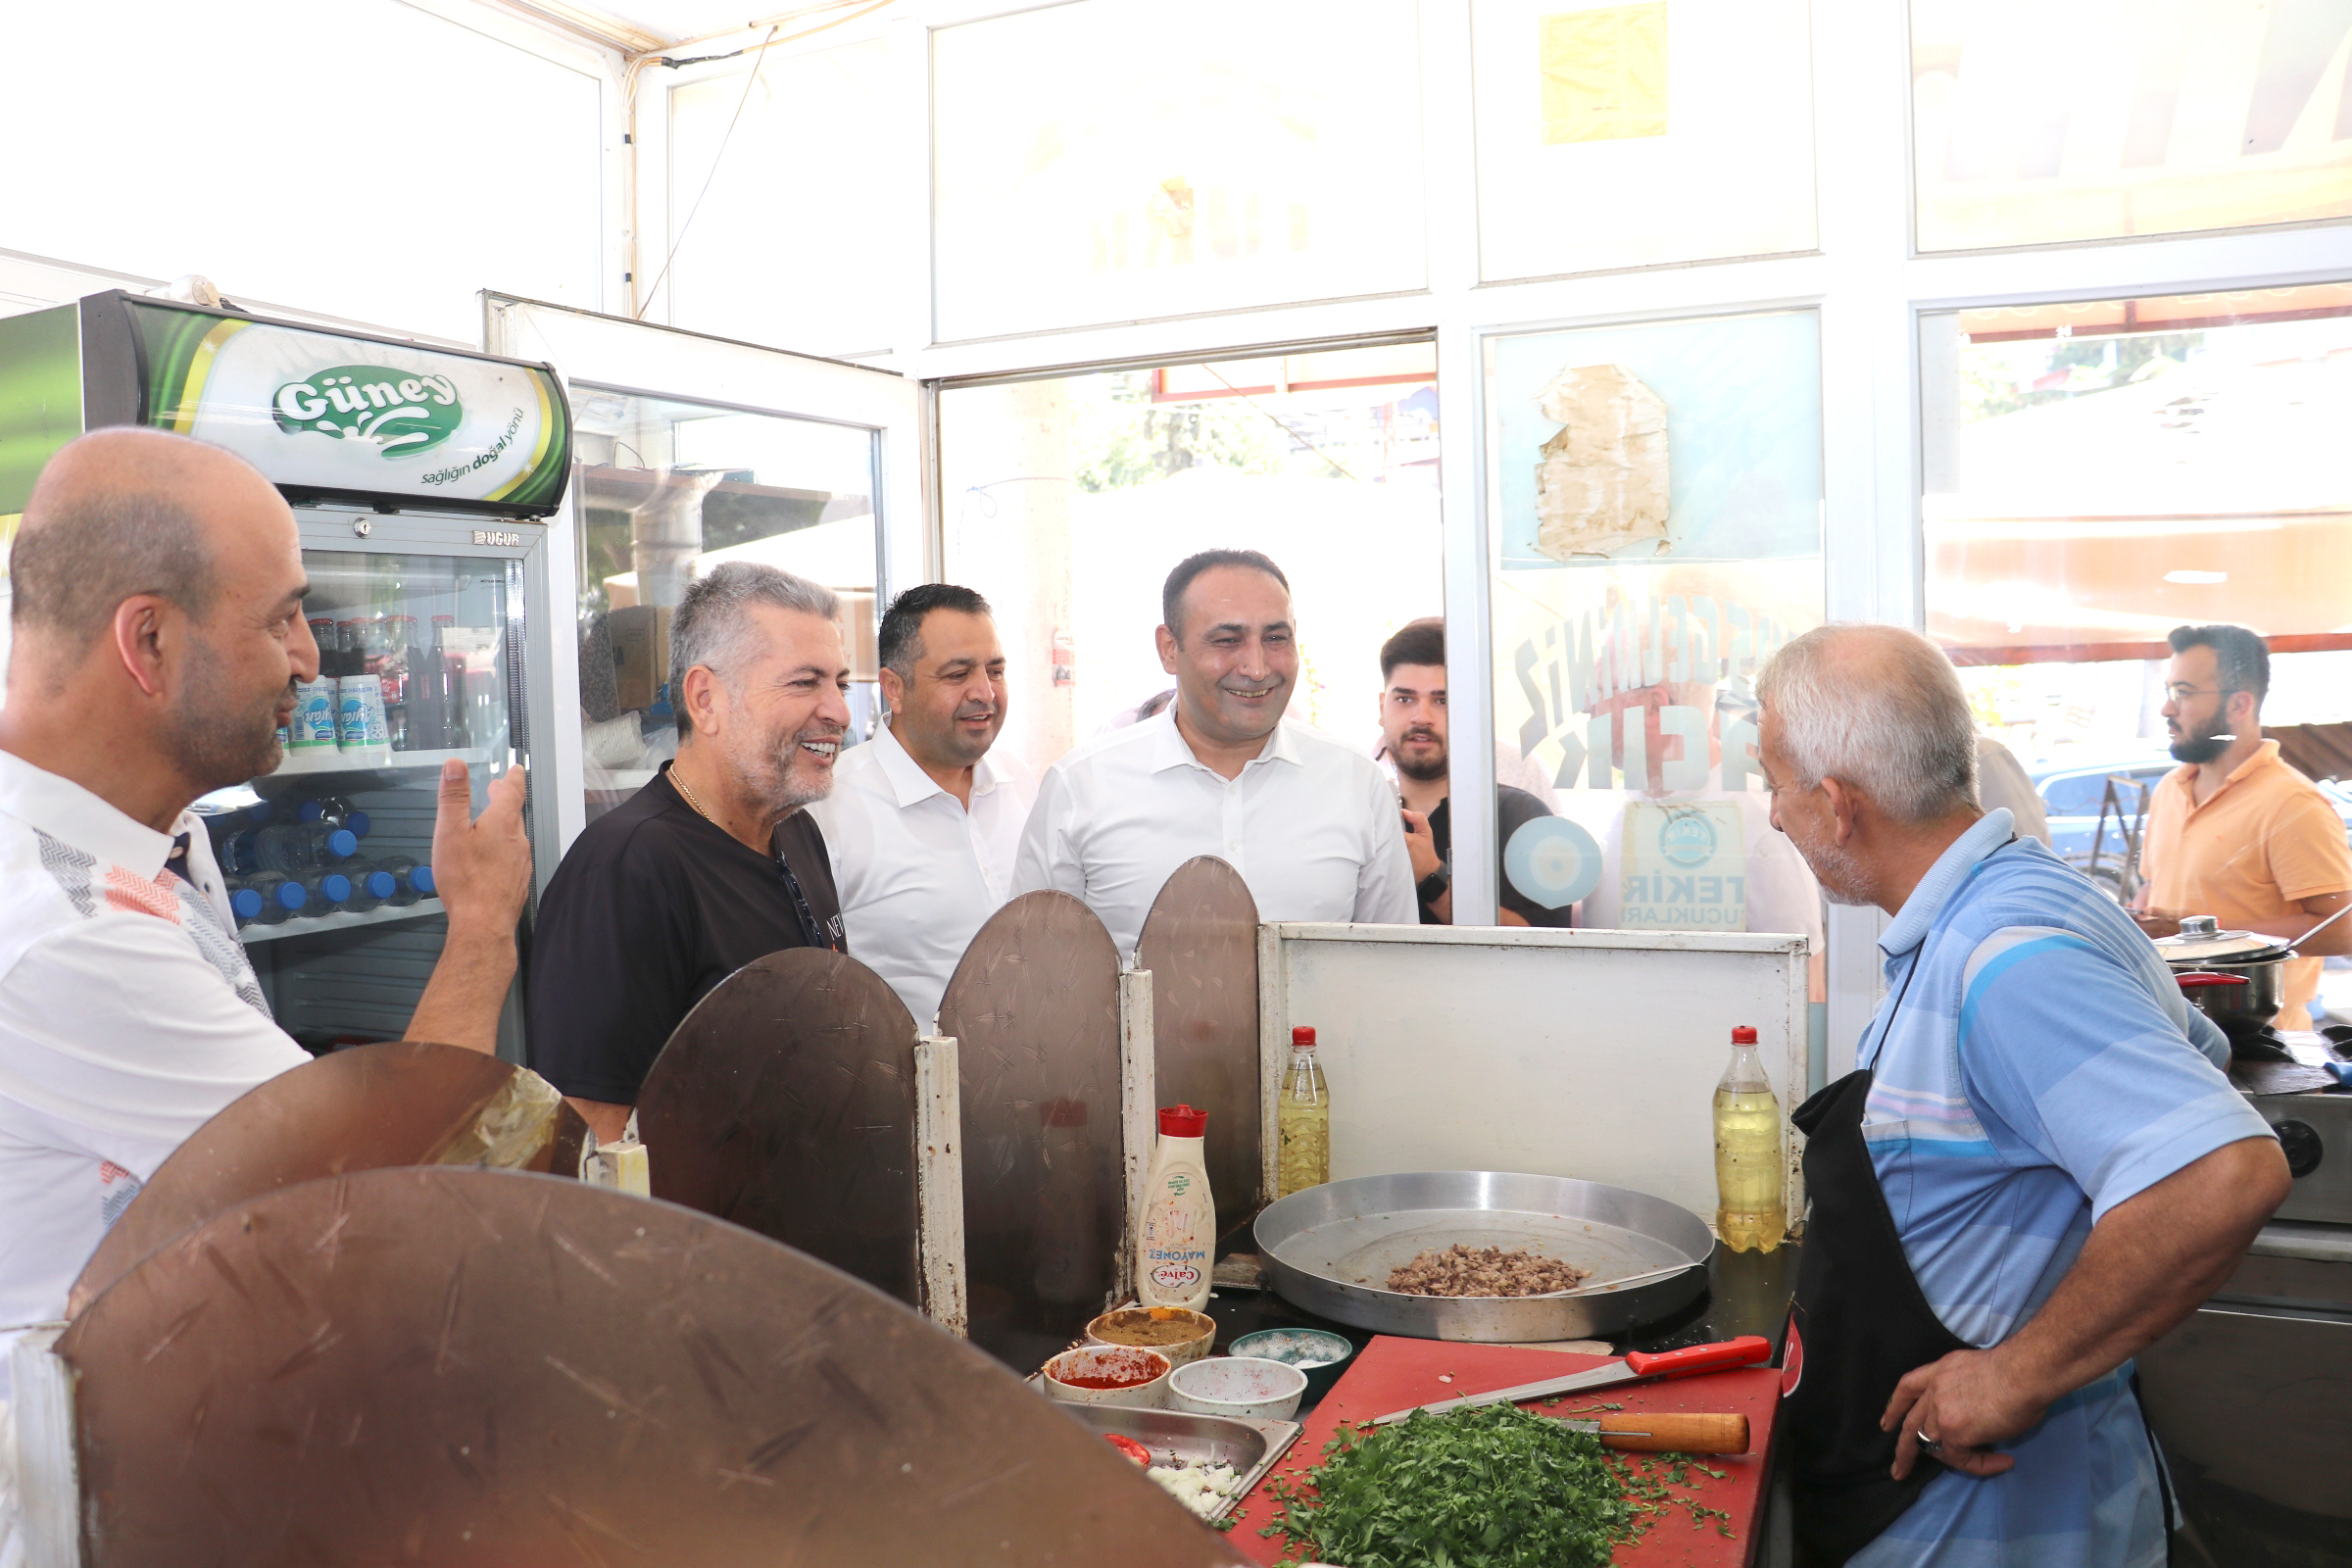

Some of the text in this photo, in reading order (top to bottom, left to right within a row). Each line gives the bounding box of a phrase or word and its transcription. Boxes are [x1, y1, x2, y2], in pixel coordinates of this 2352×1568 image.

[277, 374, 458, 420] Güney
[421, 407, 524, 486] sağlığın doğal yönü
[1149, 1249, 1205, 1261] MAYONEZ
[1160, 1270, 1195, 1281] Calvé
